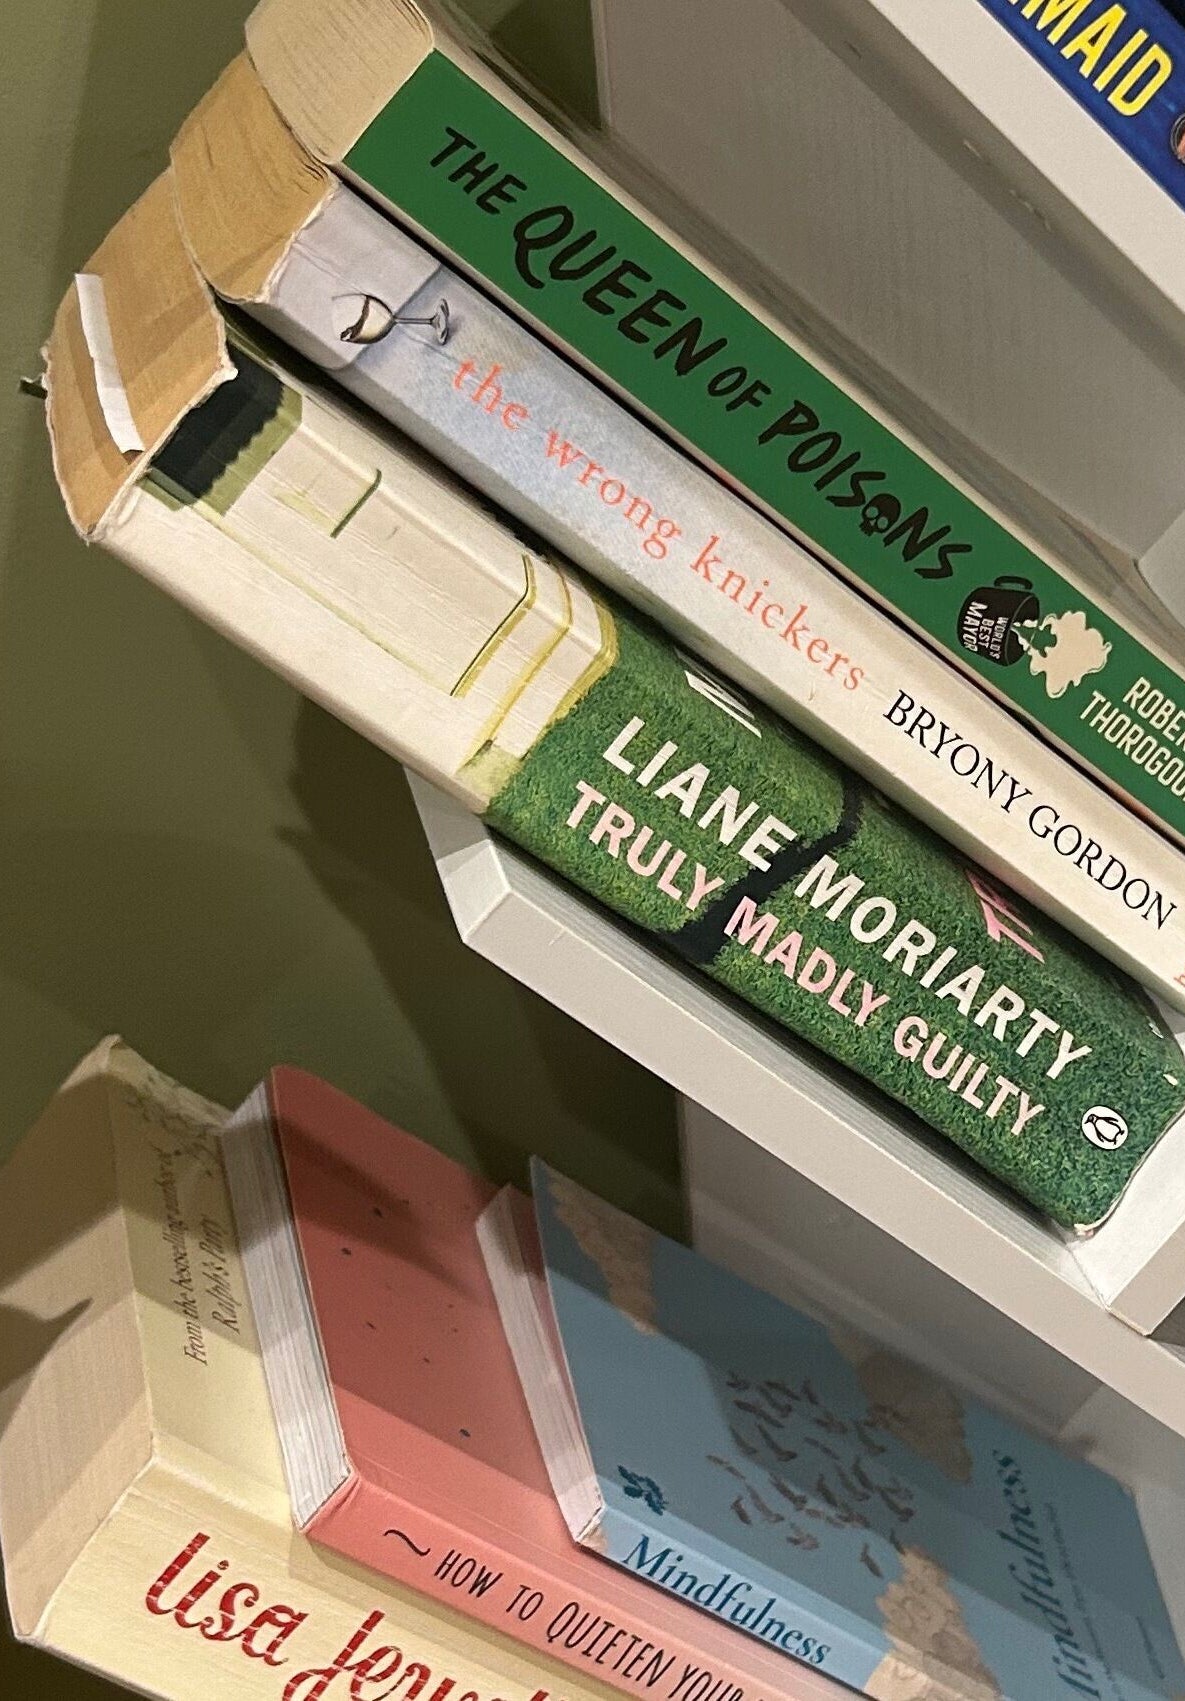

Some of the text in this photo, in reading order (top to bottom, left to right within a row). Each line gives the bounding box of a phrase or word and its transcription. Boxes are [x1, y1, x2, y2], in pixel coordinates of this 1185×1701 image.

[428, 126, 528, 216] THE
[512, 205, 732, 377] QUEEN
[708, 348, 773, 412] OF
[451, 355, 871, 692] the wrong knickers
[962, 600, 989, 652] MAYOR
[977, 617, 995, 650] BEST
[882, 689, 1179, 931] BRYONY GORDON
[564, 781, 1048, 1138] TRULY MADLY GUILTY
[601, 715, 1095, 1082] LIANE MORIARTY
[174, 1292, 199, 1321] the
[184, 1322, 208, 1366] From
[202, 1259, 242, 1335] Ralph's
[433, 1548, 503, 1599] HOW
[505, 1584, 545, 1621] TO
[546, 1601, 677, 1688] QUIETEN
[622, 1533, 832, 1666] Mindfulness
[992, 1449, 1102, 1698] indfulness
